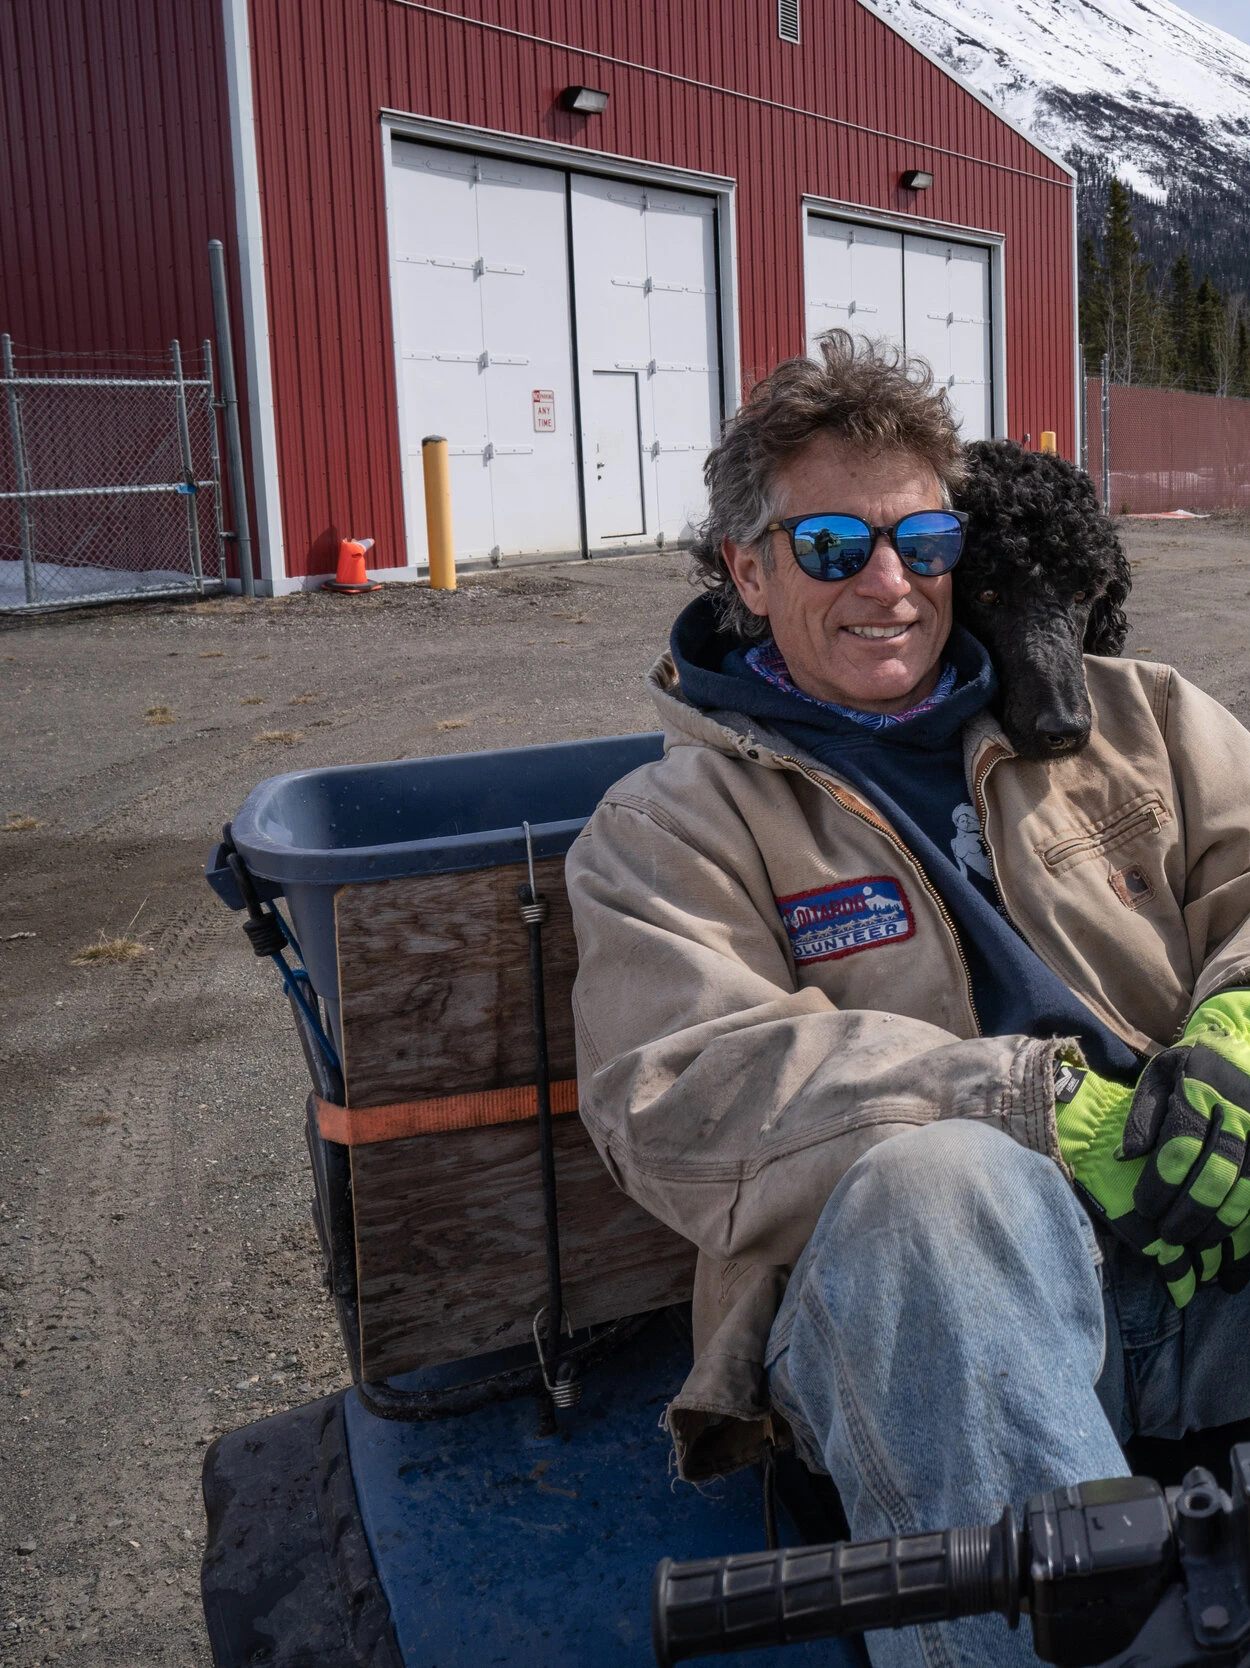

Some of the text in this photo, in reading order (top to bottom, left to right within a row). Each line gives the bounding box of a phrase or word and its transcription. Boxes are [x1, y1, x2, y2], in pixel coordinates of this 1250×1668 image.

[538, 407, 550, 415] ANY
[538, 419, 552, 427] TIME
[793, 923, 898, 956] OLUNTEER
